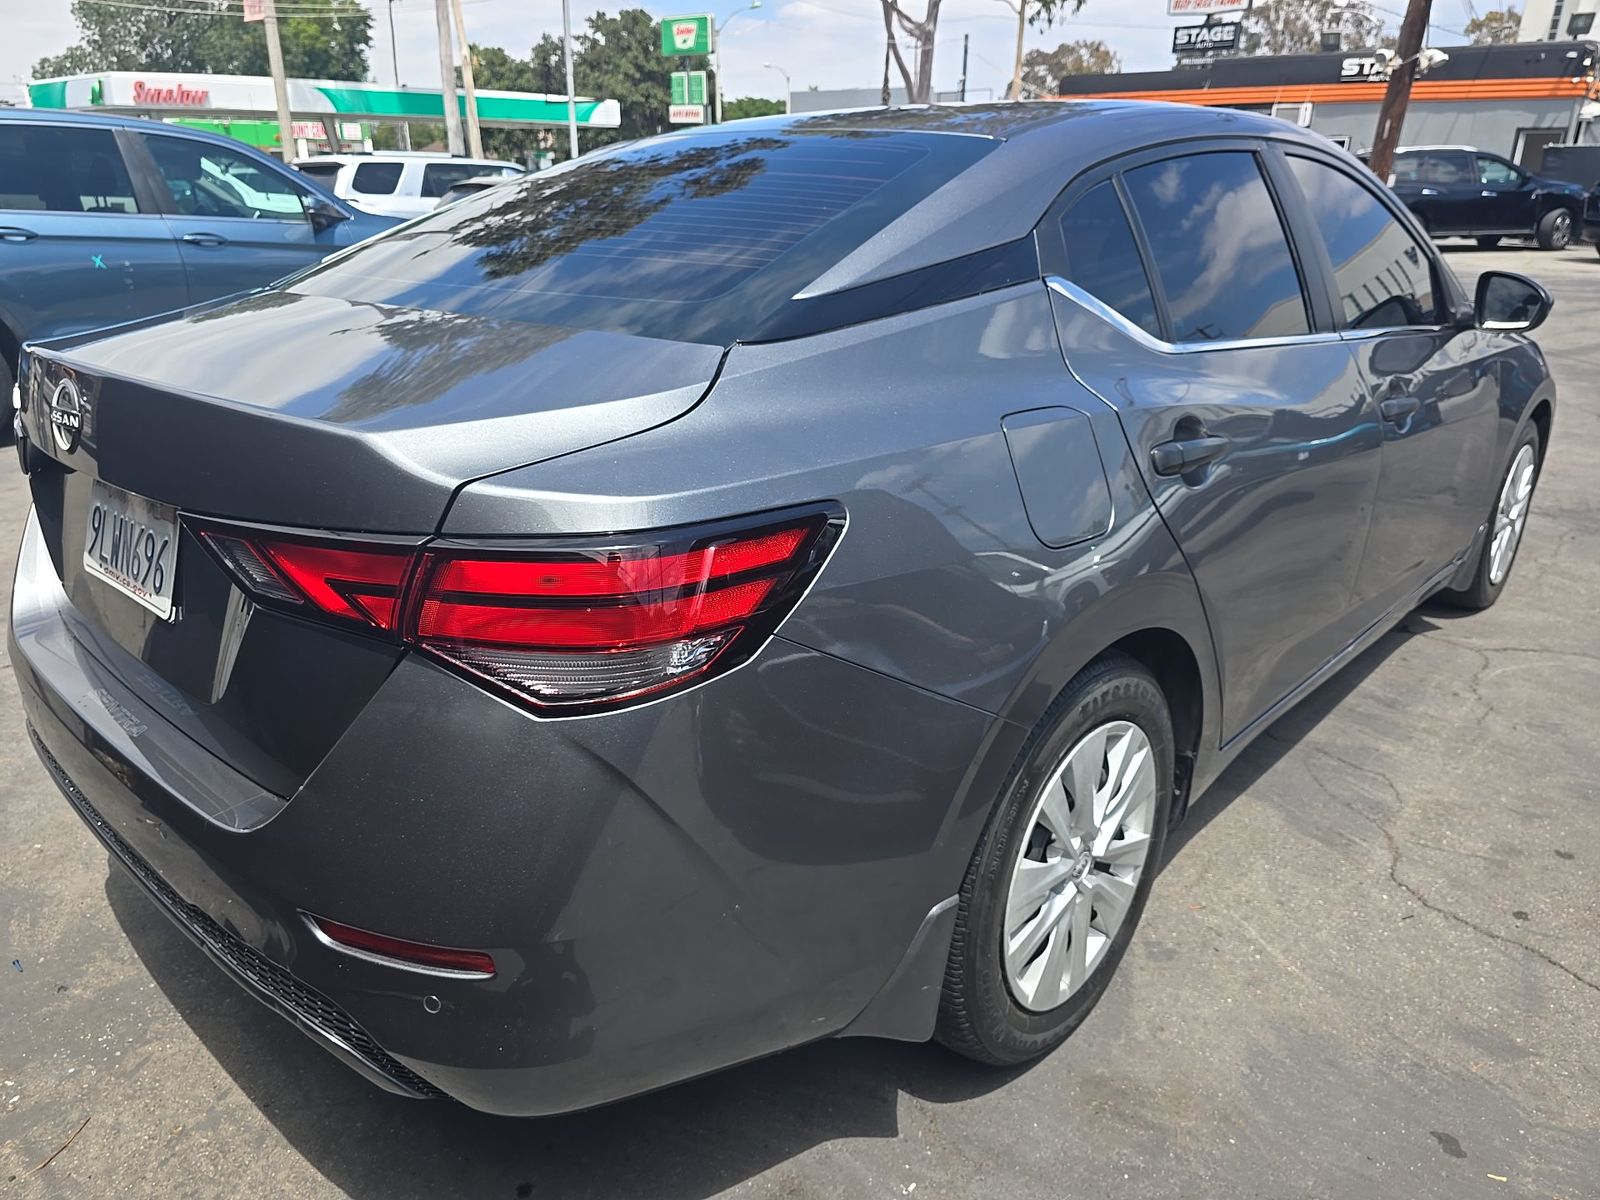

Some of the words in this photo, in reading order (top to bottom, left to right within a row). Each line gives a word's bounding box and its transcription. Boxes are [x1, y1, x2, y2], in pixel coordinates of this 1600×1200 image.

[1175, 26, 1236, 44] STAGE
[1341, 56, 1387, 76] STA
[87, 503, 169, 595] 9LWN696
